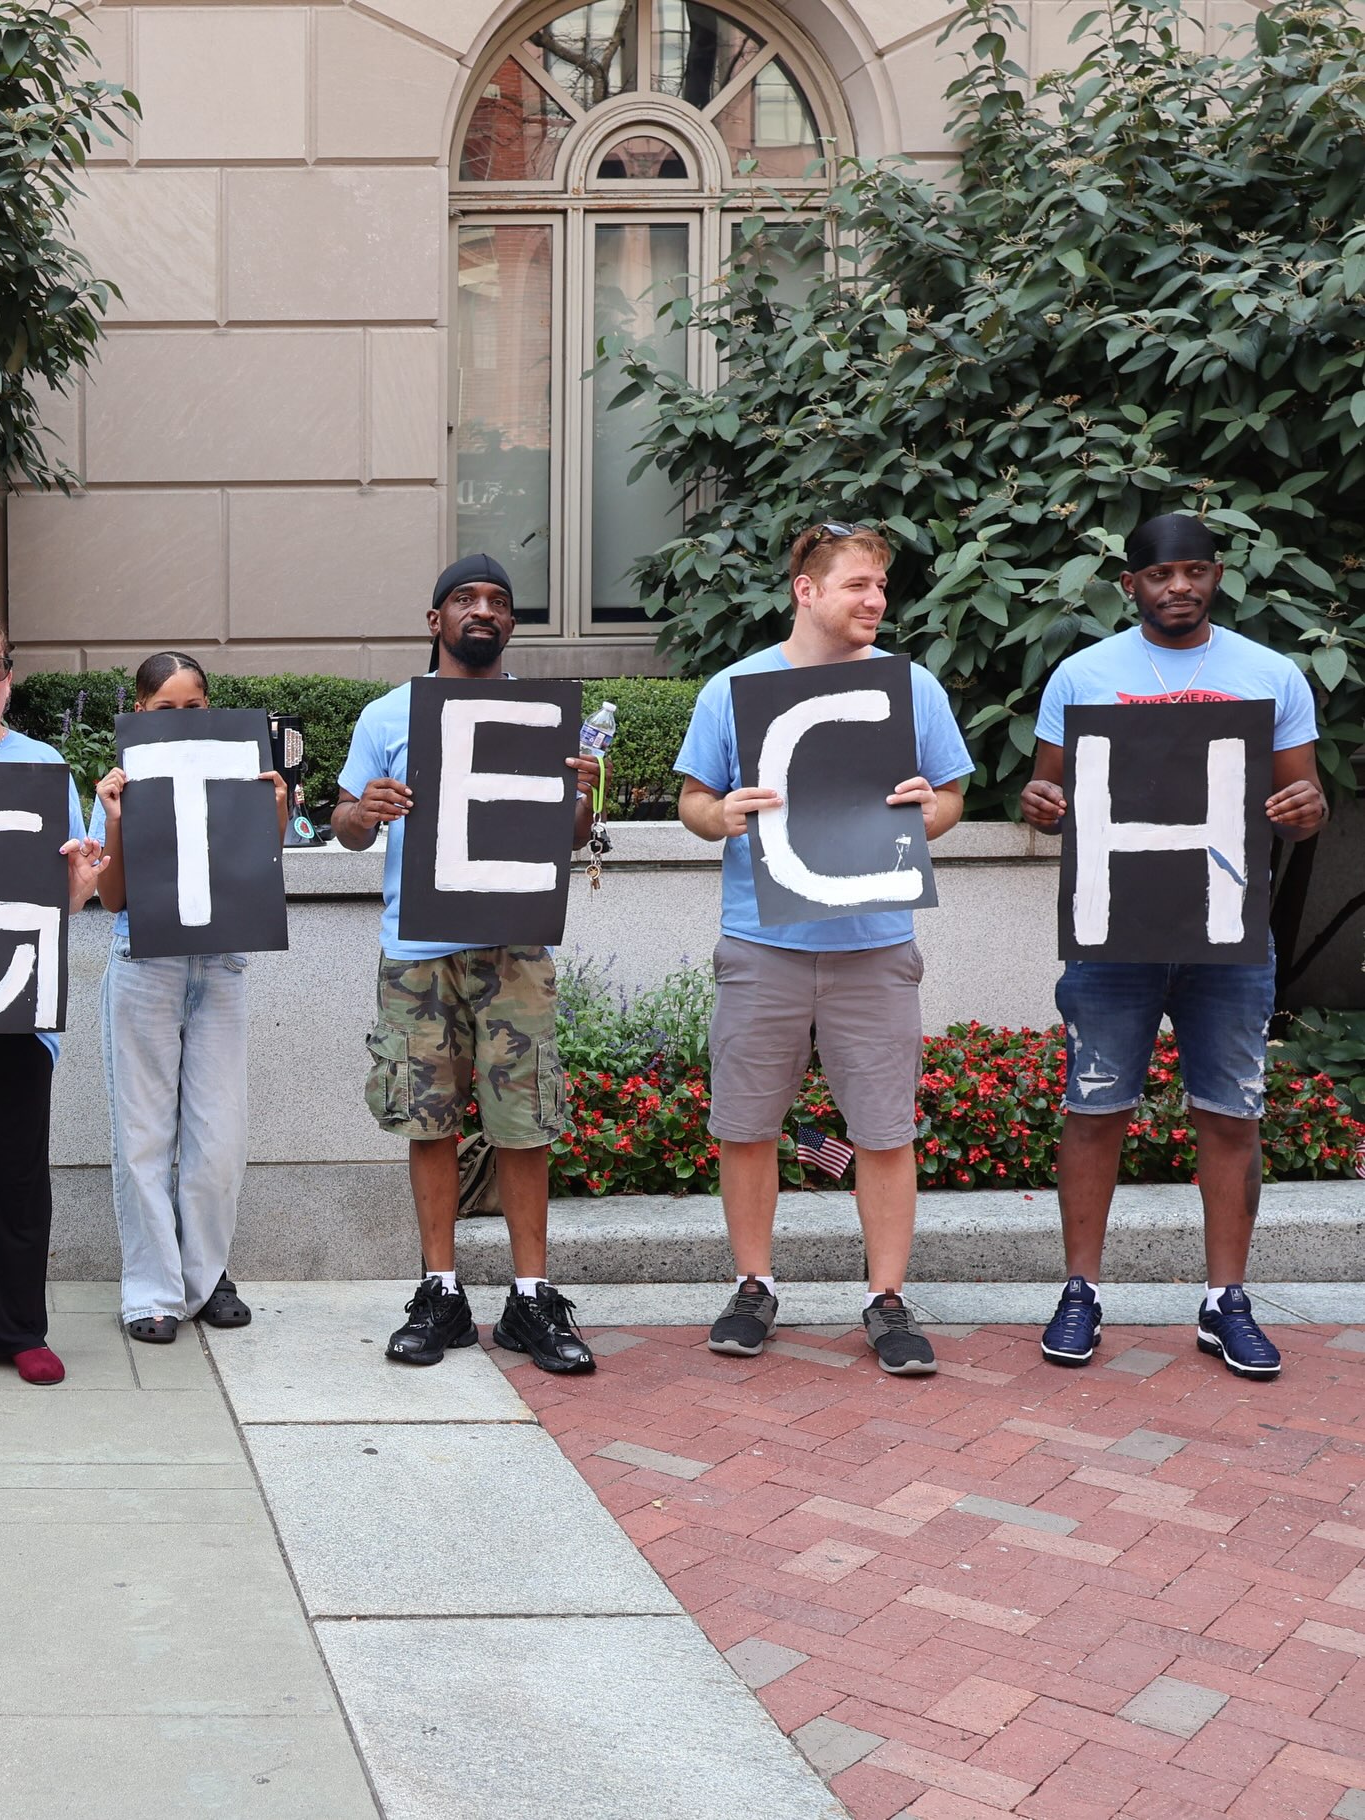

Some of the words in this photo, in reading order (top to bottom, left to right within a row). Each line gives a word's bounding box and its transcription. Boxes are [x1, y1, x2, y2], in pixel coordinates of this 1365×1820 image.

[124, 740, 260, 927] T
[434, 699, 564, 893] E
[758, 690, 923, 907] C
[1073, 735, 1247, 946] H
[393, 1344, 404, 1353] 43
[579, 1354, 590, 1363] 43
